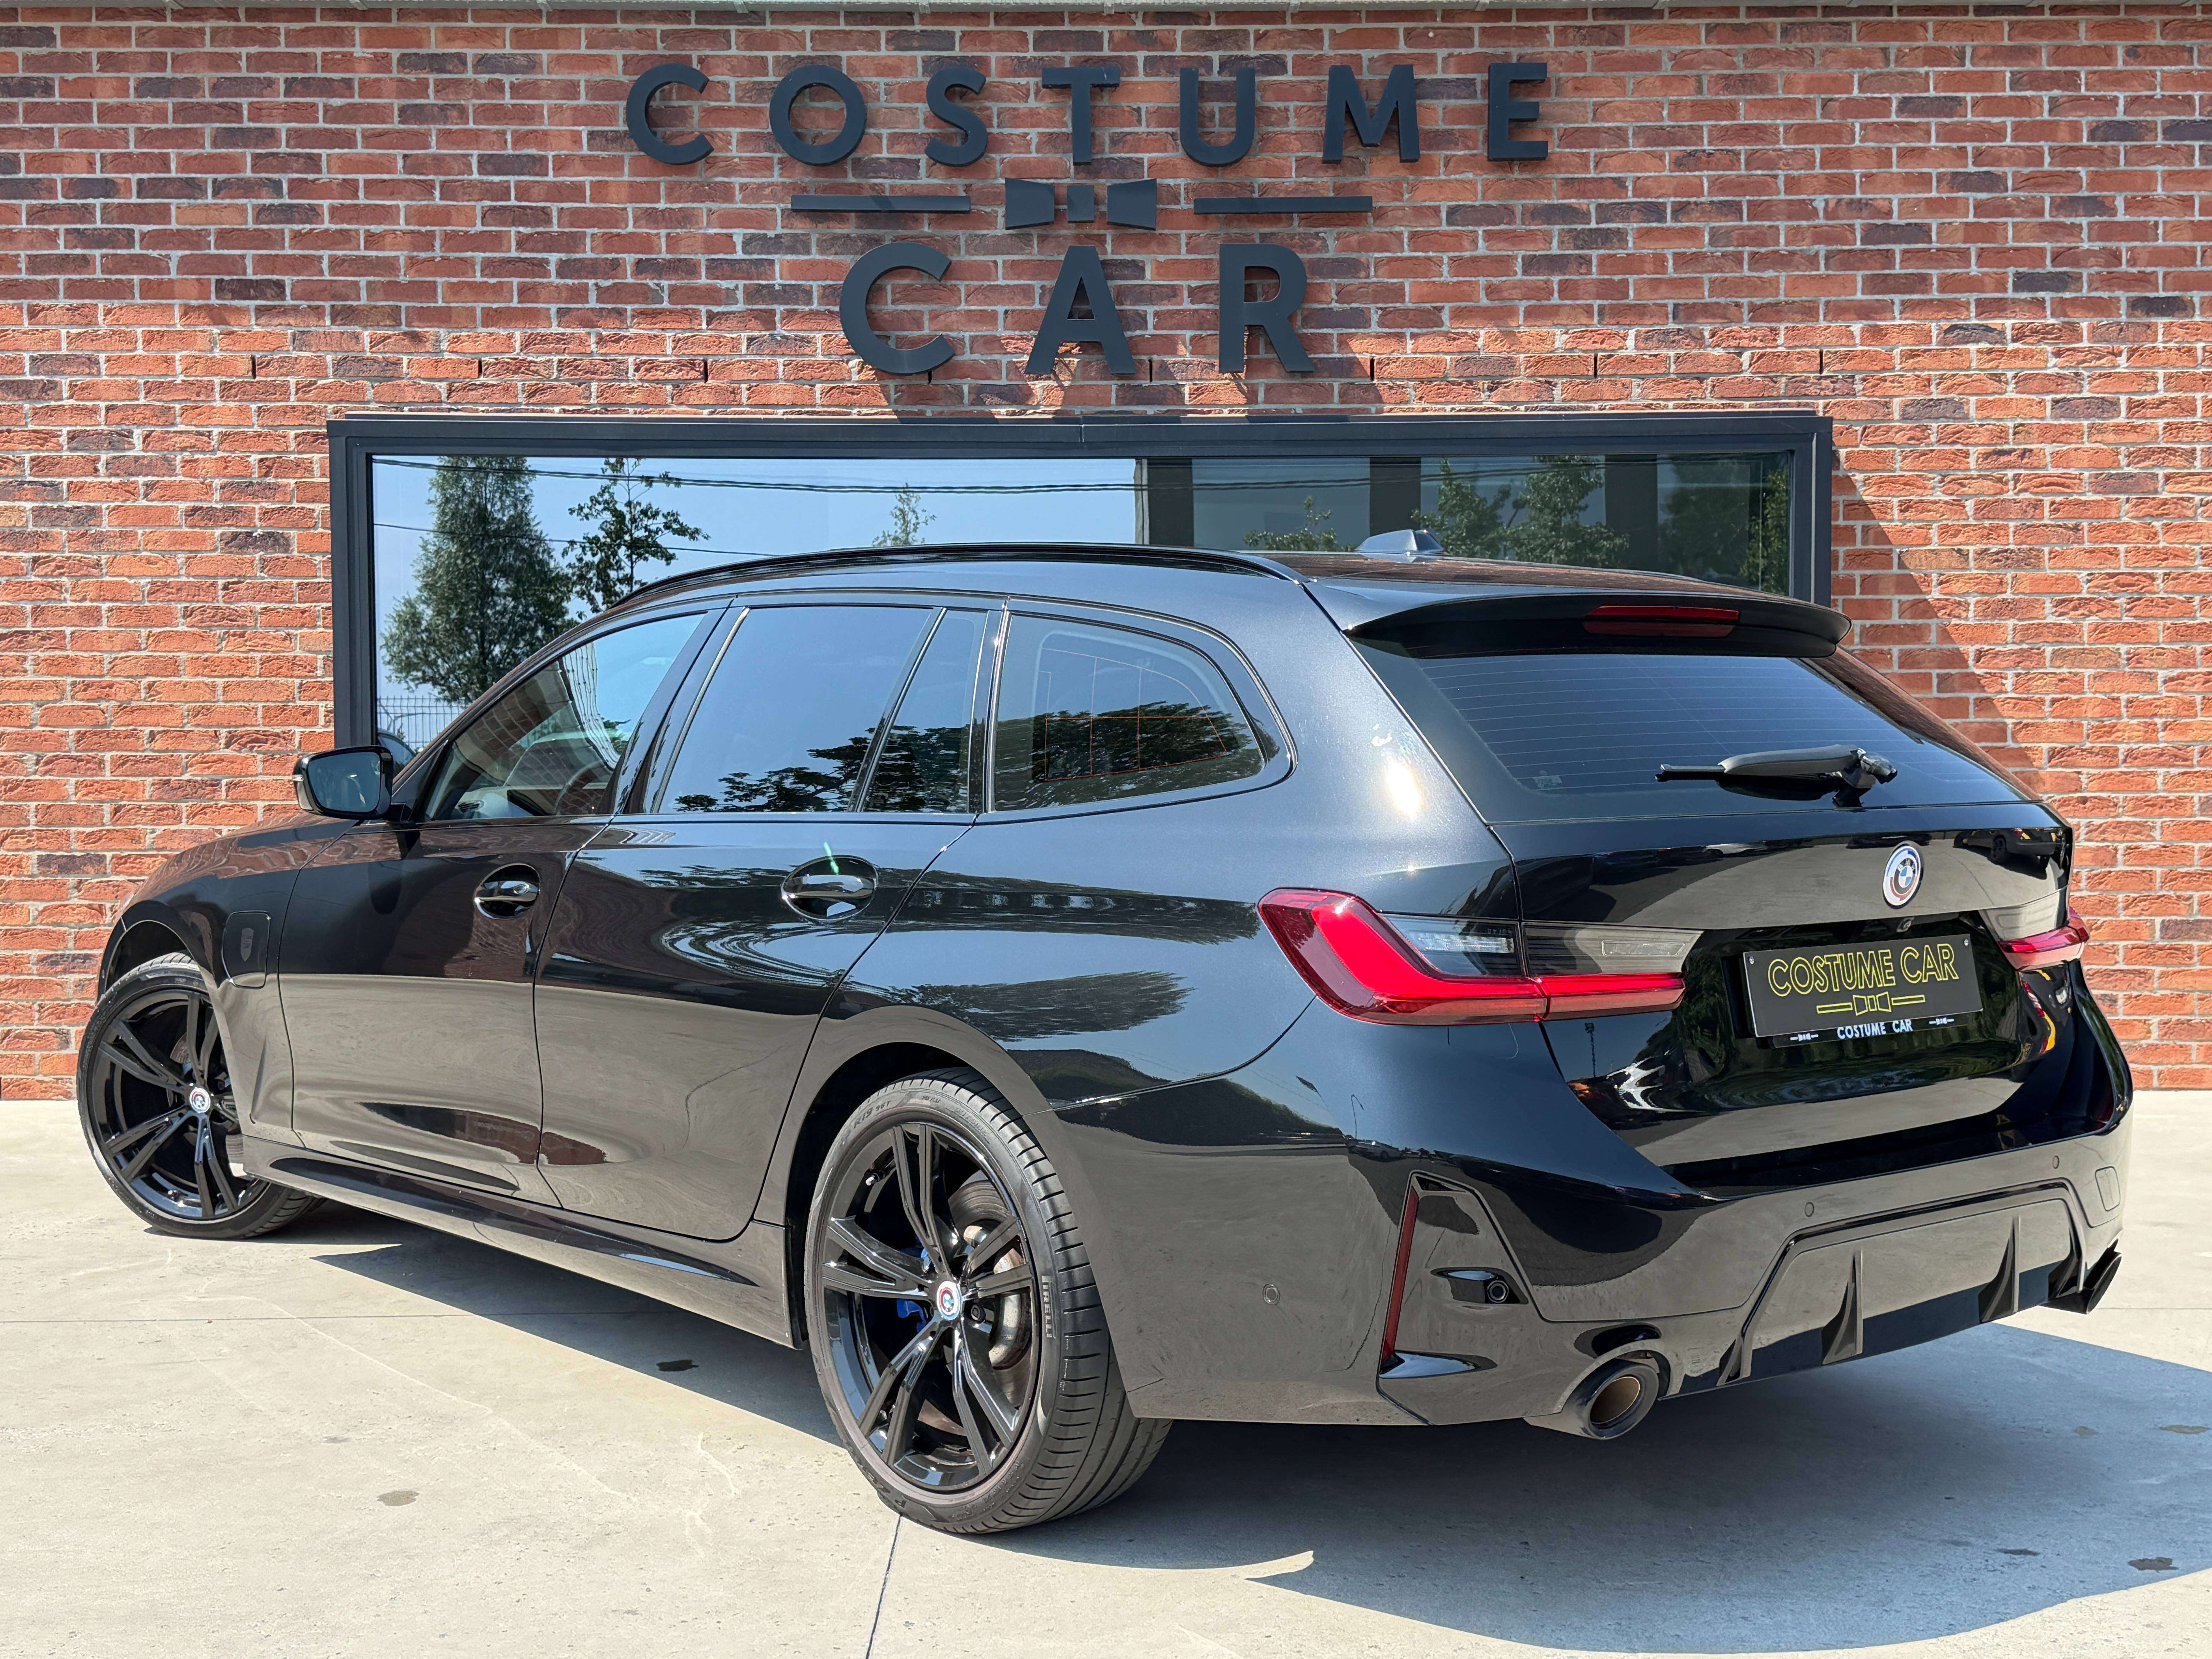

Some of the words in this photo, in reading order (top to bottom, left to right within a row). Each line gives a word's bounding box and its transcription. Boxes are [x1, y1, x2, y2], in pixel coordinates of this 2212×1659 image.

[626, 62, 1549, 167] COSTUME
[839, 242, 1315, 375] CAR
[1767, 949, 1896, 997] COSTUME
[1900, 943, 1960, 984] CAR
[1837, 1022, 1887, 1039] COSTUME
[1892, 1019, 1913, 1033] CAR
